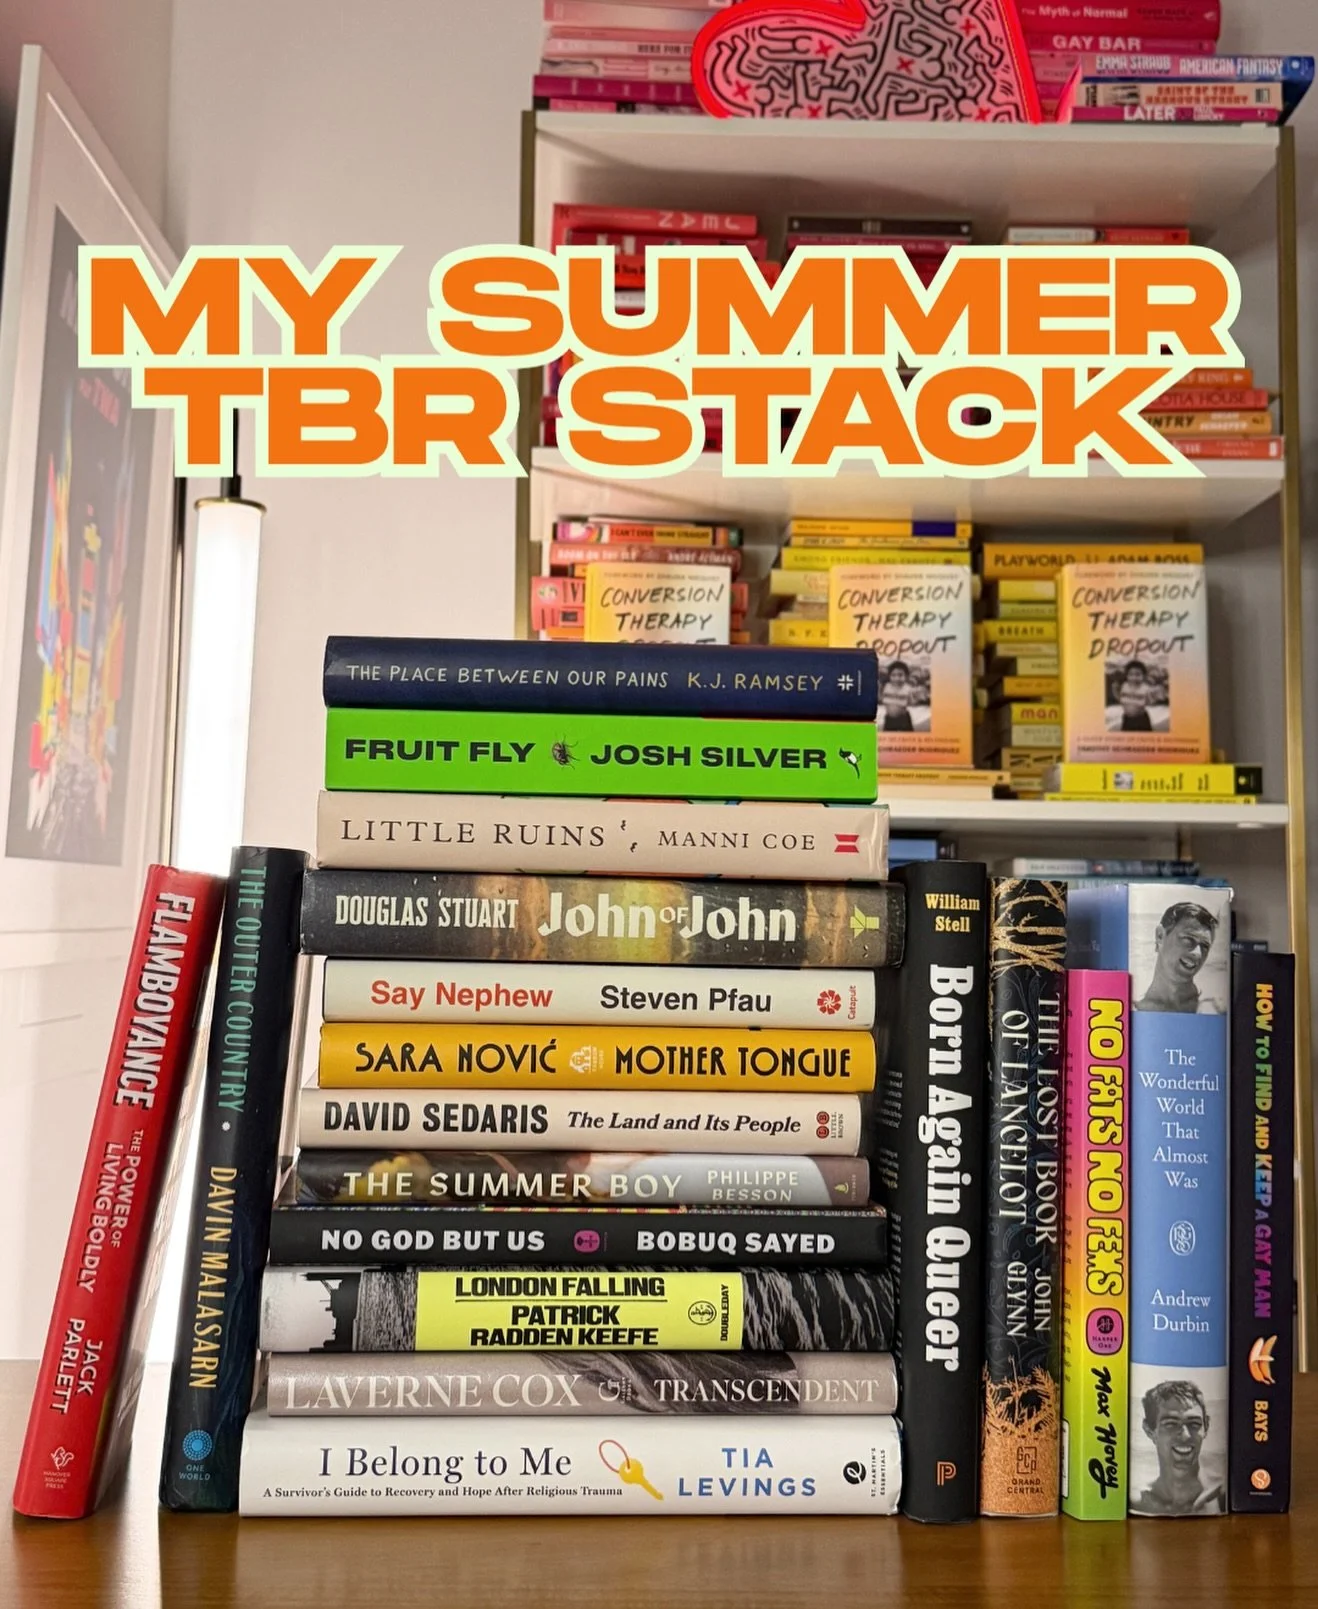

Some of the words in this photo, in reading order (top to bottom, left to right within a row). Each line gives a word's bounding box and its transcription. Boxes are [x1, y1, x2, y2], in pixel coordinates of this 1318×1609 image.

[1039, 6, 1070, 18] Myth
[1083, 6, 1128, 18] Normal
[1052, 35, 1093, 50] GAY
[1098, 36, 1142, 51] BAR
[1096, 55, 1127, 70] EMMA
[1130, 55, 1171, 71] STRAUB
[1180, 58, 1235, 75] AMERICAN
[1237, 58, 1283, 76] FANTASY
[1124, 106, 1176, 121] LATER
[994, 554, 1076, 567] PLAYWORLD
[600, 584, 724, 608] CONVERSION
[838, 582, 964, 610] CONVERSION
[1072, 580, 1201, 608] CONVERSION
[615, 612, 712, 630] THERAPY
[852, 612, 952, 632] THERAPY
[998, 626, 1045, 636] BREATH
[1087, 610, 1190, 631] THERAPY
[1088, 635, 1194, 661] DROPOUT
[347, 665, 381, 681] THE
[389, 666, 447, 682] PLACE
[458, 668, 559, 684] BETWEEN
[567, 670, 606, 686] OUR
[616, 671, 669, 688] PAINS
[687, 672, 726, 689] K.J.
[734, 674, 824, 691] RAMSEY
[345, 739, 460, 760] FRUIT
[469, 742, 536, 763] FLY
[591, 744, 691, 766] JOSH
[701, 747, 827, 769] SILVER
[341, 820, 475, 843] LITTLE
[493, 823, 605, 847] RUINS
[658, 830, 749, 848] MANNI
[762, 834, 815, 850] COE
[237, 866, 267, 909] THE
[925, 893, 980, 911] William
[335, 895, 429, 926] DOUGLAS
[438, 898, 519, 929] STUART
[537, 892, 656, 938] John
[659, 907, 688, 924] OF
[679, 895, 796, 941] John
[935, 916, 970, 933] Stell
[229, 917, 263, 993] OUTER
[113, 892, 195, 1109] FLAMBOYANCE
[370, 980, 425, 1011] Say
[436, 982, 553, 1012] Nephew
[600, 984, 698, 1010] Steven
[709, 988, 772, 1012] Pfau
[847, 985, 857, 1019] Catapult
[1255, 983, 1273, 1031] HOW
[929, 964, 974, 1076] Born
[1002, 1010, 1029, 1056] OF
[1037, 992, 1060, 1056] THE
[1088, 998, 1124, 1060] NO
[219, 1001, 255, 1112] COUNTRY
[356, 1042, 443, 1072] SARA
[458, 1039, 557, 1073] NOVIĆ
[615, 1045, 727, 1075] MOTHER
[738, 1046, 851, 1077] TONGUE
[1165, 1049, 1196, 1066] The
[1256, 1036, 1270, 1059] TO
[1139, 1071, 1219, 1091] Wonderful
[1255, 1063, 1273, 1111] FIND
[324, 1102, 410, 1131] DAVID
[422, 1103, 549, 1134] SEDARIS
[568, 1111, 604, 1129] The
[608, 1112, 660, 1130] Land
[663, 1114, 700, 1131] and
[704, 1114, 730, 1131] Its
[733, 1115, 801, 1136] People
[1036, 1068, 1059, 1141] LOST
[1087, 1065, 1124, 1146] FATS
[1157, 1097, 1205, 1115] World
[130, 1130, 144, 1153] THE
[999, 1061, 1029, 1225] LANCELOT
[1162, 1122, 1199, 1139] That
[1255, 1114, 1272, 1150] AND
[918, 1085, 972, 1215] Again
[1152, 1146, 1208, 1164] Almost
[95, 1142, 124, 1214] LIVING
[111, 1155, 139, 1229] POWER
[343, 1172, 413, 1197] THE
[429, 1171, 592, 1198] SUMMER
[609, 1174, 682, 1198] BOY
[707, 1170, 799, 1186] PHILIPPE
[1087, 1150, 1124, 1213] NO
[1164, 1171, 1198, 1188] Was
[1254, 1153, 1273, 1207] KEEP
[203, 1166, 237, 1243] DAVIN
[712, 1188, 793, 1202] BESSON
[1035, 1161, 1058, 1244] BOOK
[1254, 1209, 1263, 1221] A
[78, 1214, 108, 1294] BOLDLY
[111, 1230, 122, 1248] OF
[321, 1229, 363, 1250] NO
[371, 1230, 434, 1250] GOD
[443, 1230, 500, 1250] BUT
[507, 1231, 545, 1251] US
[637, 1231, 737, 1255] BOBUQ
[745, 1233, 836, 1254] SAYED
[1253, 1224, 1272, 1272] GAY
[1085, 1217, 1124, 1296] FEMS
[455, 1277, 556, 1296] LONDON
[562, 1277, 665, 1296] FALLING
[925, 1225, 971, 1372] Queer
[1006, 1261, 1028, 1337] GLYNN
[1033, 1268, 1052, 1331] JOHN
[1151, 1289, 1211, 1307] Andrew
[1253, 1272, 1272, 1319] MAN
[188, 1251, 229, 1389] MALASARN
[511, 1305, 620, 1325] PATRICK
[720, 1284, 729, 1341] DOUBLEDAY
[1153, 1313, 1209, 1333] Durbin
[470, 1328, 572, 1346] RADDEN
[578, 1328, 659, 1346] KEEFE
[50, 1317, 86, 1415] PARLETT
[76, 1340, 103, 1397] JACK
[285, 1374, 482, 1409] LAVERNE
[492, 1373, 583, 1408] COX
[653, 1378, 879, 1402] TRANSCENDENT
[1091, 1366, 1113, 1417] Max
[1254, 1401, 1269, 1442] BAYS
[319, 1448, 333, 1476] I
[345, 1446, 464, 1483] Belong
[474, 1450, 508, 1476] to
[519, 1447, 572, 1476] Me
[721, 1448, 773, 1468] TIA
[1087, 1422, 1118, 1499] Hovey
[179, 1472, 211, 1480] WORLD
[678, 1477, 816, 1497] LEVINGS
[263, 1488, 272, 1497] A
[275, 1487, 331, 1498] Survivor's
[334, 1487, 368, 1497] Guide
[371, 1487, 382, 1497] to
[385, 1487, 436, 1499] Recovery
[438, 1486, 459, 1497] and
[462, 1487, 492, 1499] Hope
[494, 1486, 524, 1497] After
[526, 1486, 578, 1499] Religious
[581, 1486, 623, 1496] Trauma
